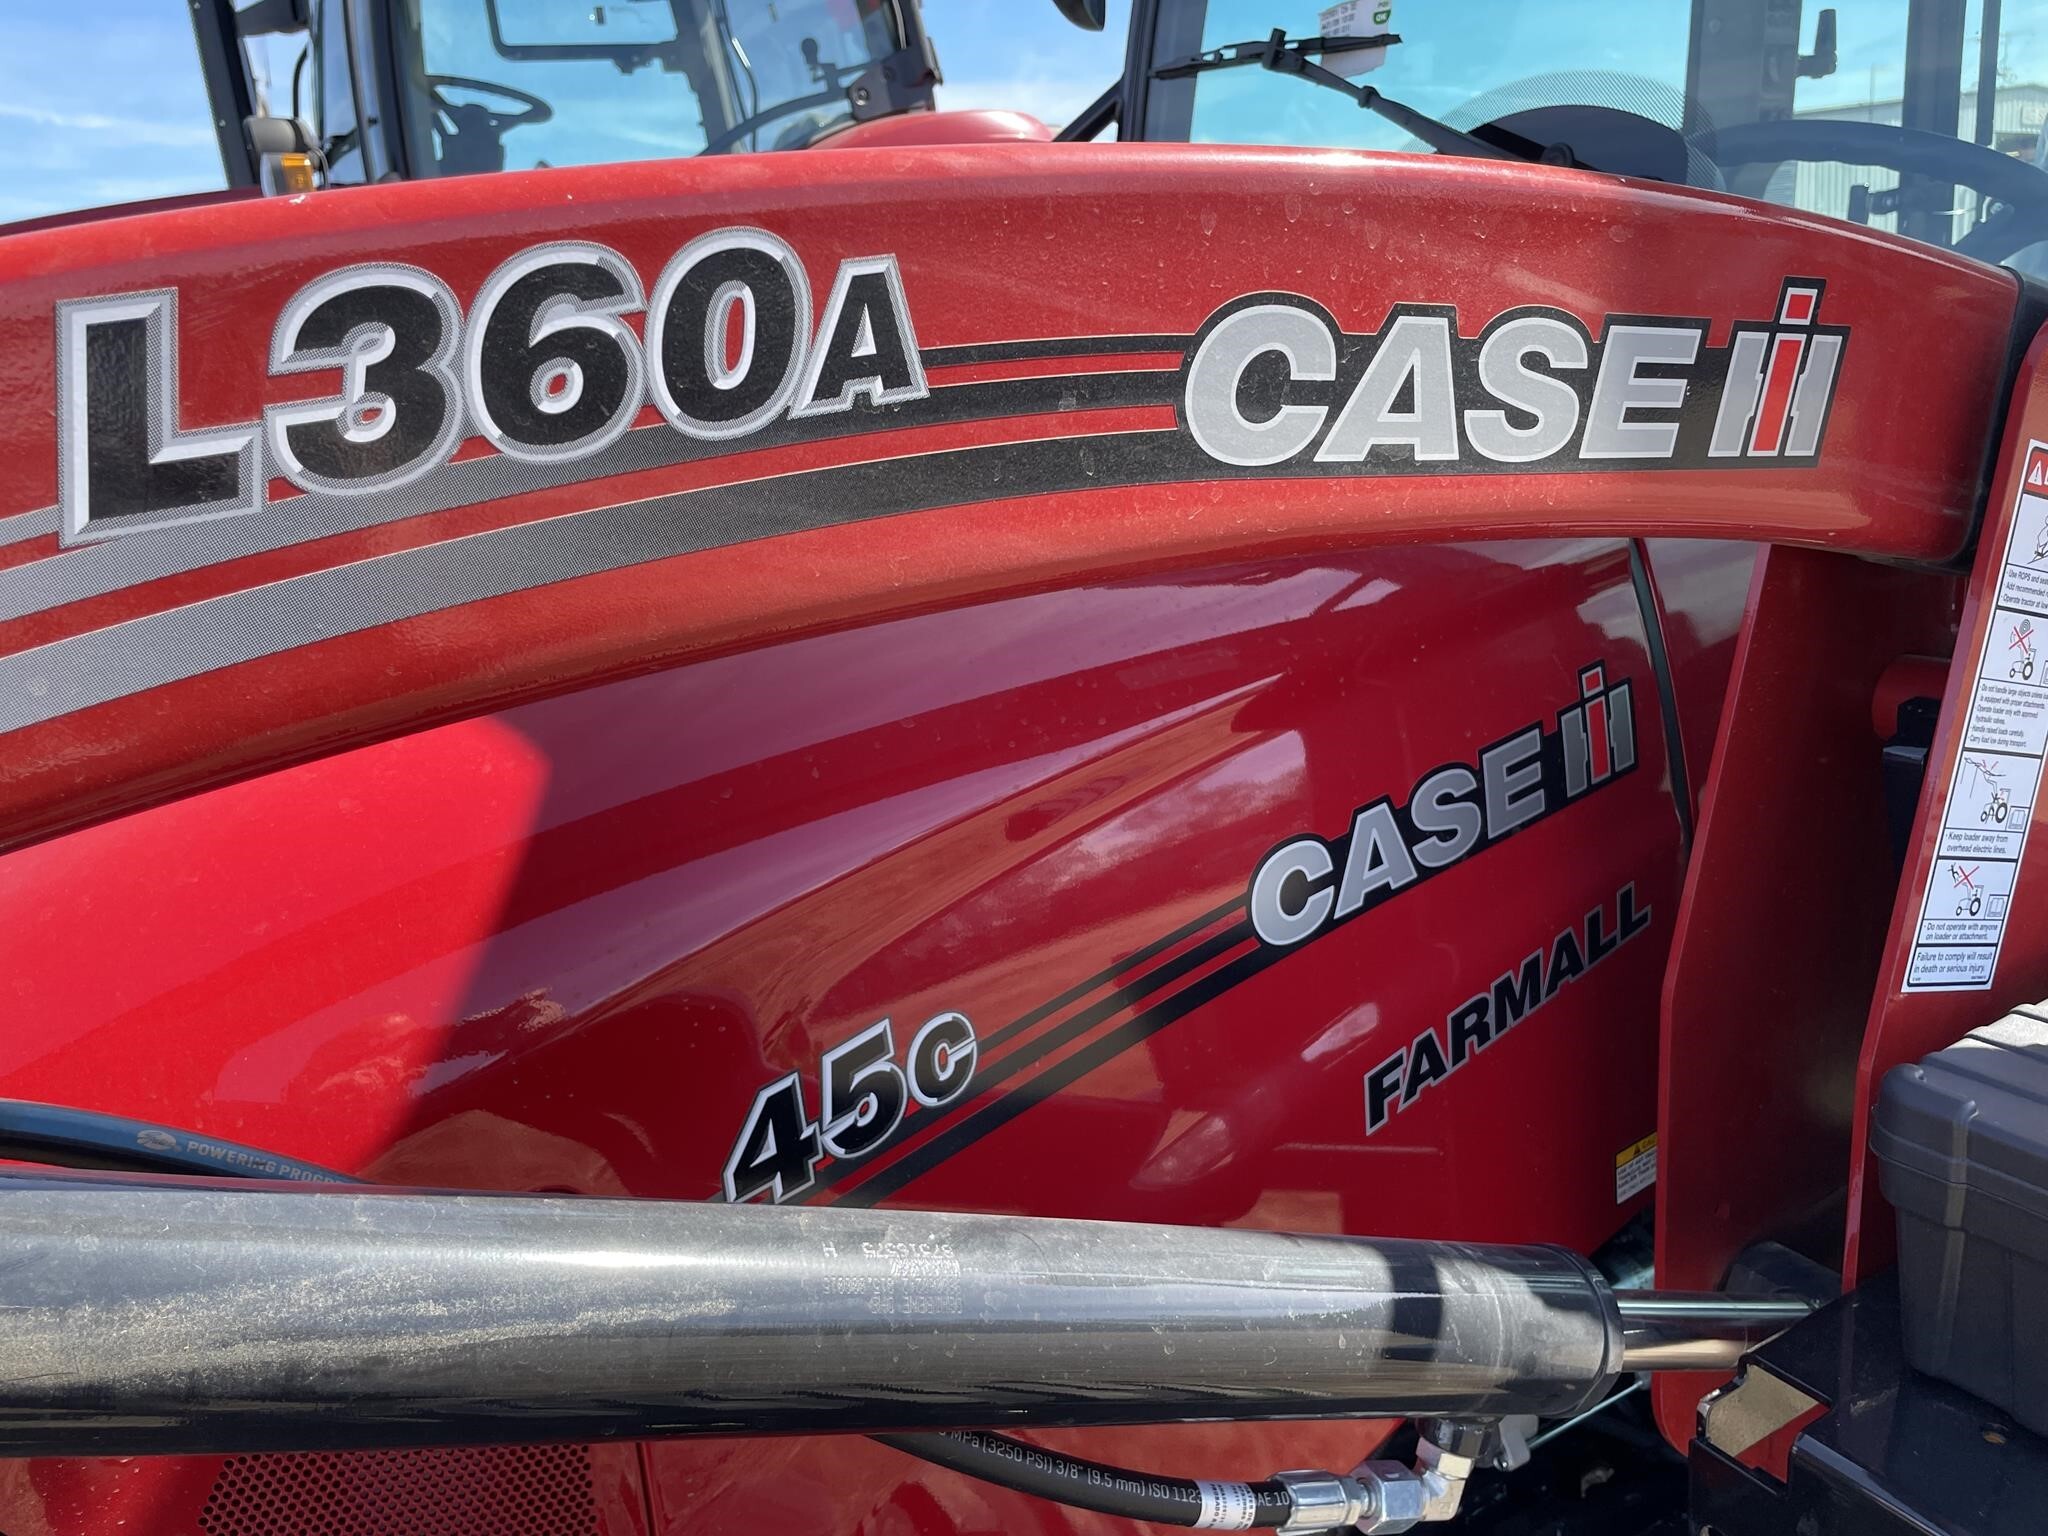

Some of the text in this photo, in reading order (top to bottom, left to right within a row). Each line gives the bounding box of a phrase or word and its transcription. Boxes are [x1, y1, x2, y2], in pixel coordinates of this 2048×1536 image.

[56, 226, 930, 549] L360A
[1185, 304, 1702, 466] CASE
[2018, 571, 2031, 581] ROPS
[2003, 594, 2020, 604] Operate
[1970, 734, 1980, 744] Carry
[1251, 728, 1545, 946] CASE
[1948, 832, 2008, 844] Keep loader away from
[1946, 844, 1972, 852] overhead
[1972, 845, 1992, 853] electric
[1946, 924, 1966, 932] operate
[1980, 924, 1998, 932] anyone
[1916, 952, 1936, 960] Failure
[1944, 952, 1965, 962] comply
[1966, 952, 1977, 960] will
[1977, 952, 1992, 960] result
[1921, 964, 1938, 974] death
[1946, 964, 1967, 972] serious
[1968, 965, 1984, 975] injury.
[1364, 881, 1652, 1136] FARMALL
[722, 1012, 978, 1204] 45C
[186, 1140, 276, 1173] POWERING
[983, 1438, 1023, 1462] (3250
[1026, 1448, 1052, 1474] PSI)
[1116, 1474, 1146, 1497] mm)
[1148, 1481, 1170, 1500] ISO
